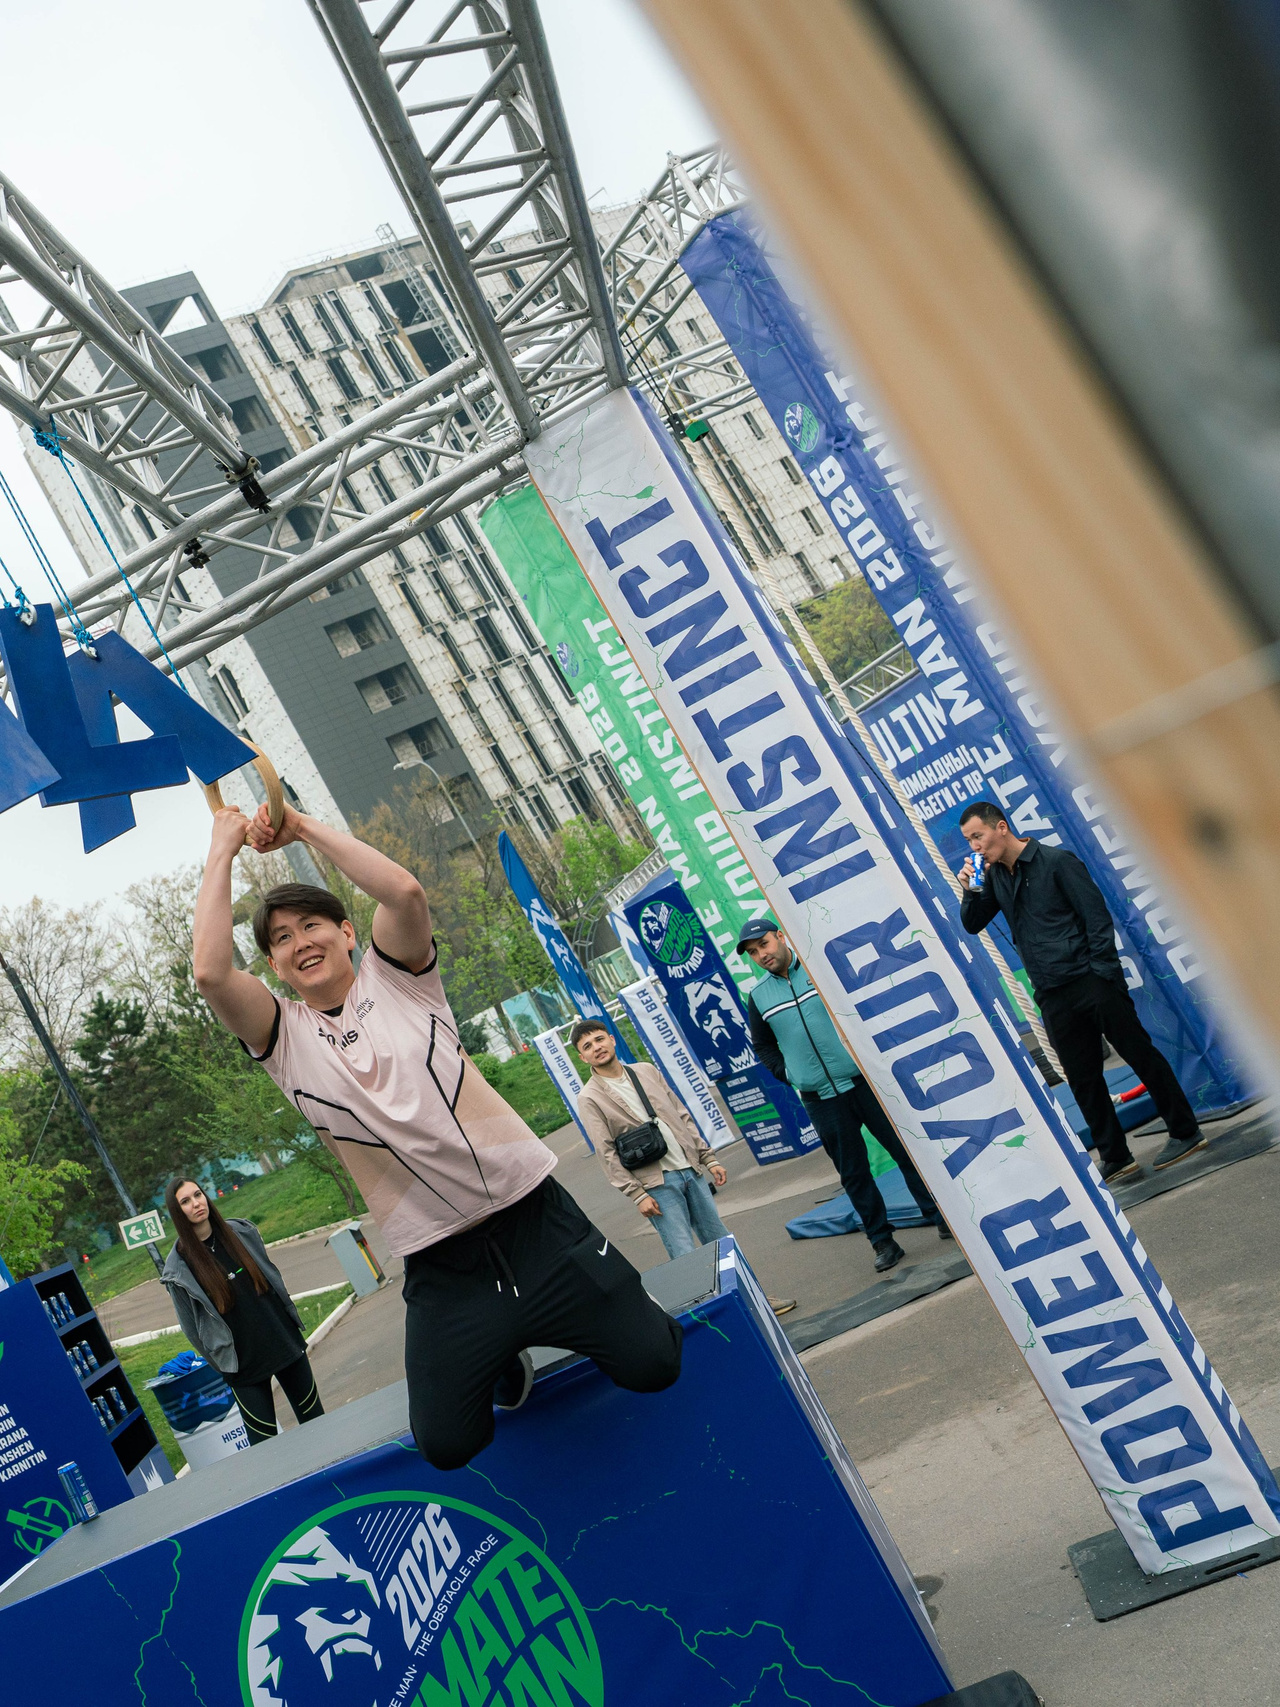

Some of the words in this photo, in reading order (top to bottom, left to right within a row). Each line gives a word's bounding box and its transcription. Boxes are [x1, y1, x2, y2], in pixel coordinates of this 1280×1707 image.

[810, 455, 905, 591] 2026
[585, 498, 876, 904] INSTINCT
[892, 597, 985, 727] MAN
[577, 682, 643, 787] 2026
[637, 795, 701, 891] MAN
[913, 786, 956, 823] АБЕГИ
[543, 1036, 558, 1054] BER
[637, 988, 659, 1018] BER
[651, 1013, 678, 1049] KUCH
[824, 907, 1025, 1180] YOUR
[554, 1054, 572, 1078] KUCH
[670, 1047, 727, 1131] HISSIYOTINGA
[979, 1186, 1255, 1553] POWER
[221, 1424, 248, 1444] HISSI
[235, 1437, 250, 1451] KU
[385, 1502, 461, 1651] 2026
[414, 1627, 434, 1658] THE
[427, 1564, 471, 1632] OBSTACLE
[466, 1533, 499, 1569] RACE
[409, 1552, 566, 1707] MATE
